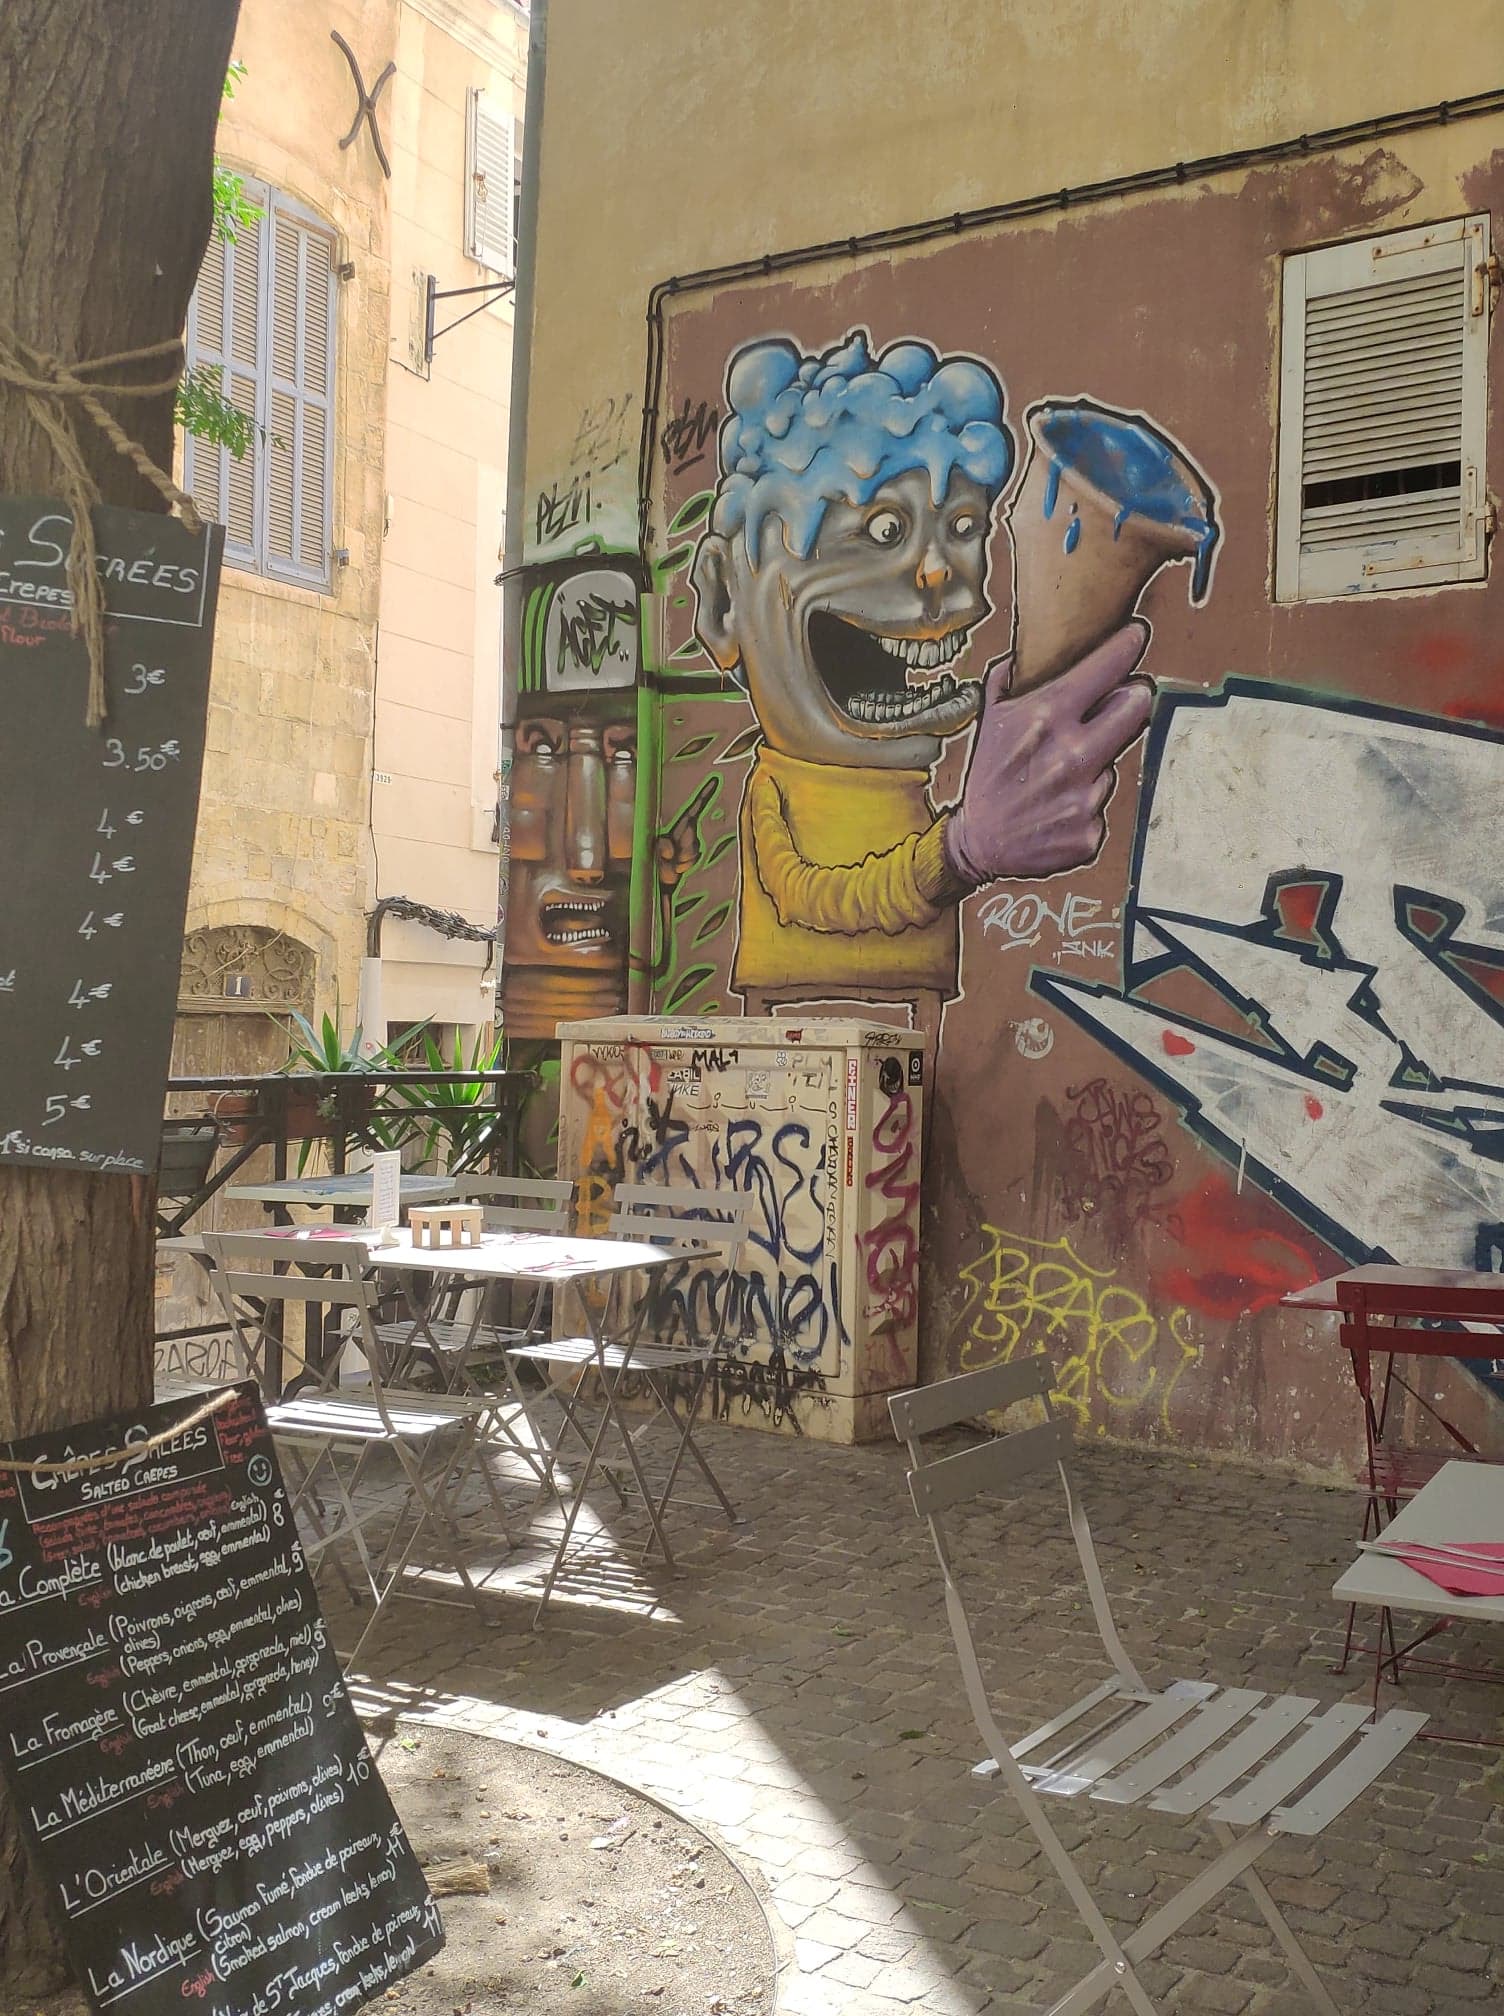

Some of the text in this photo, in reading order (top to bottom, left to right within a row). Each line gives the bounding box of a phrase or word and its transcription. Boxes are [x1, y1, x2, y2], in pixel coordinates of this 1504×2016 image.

[124, 663, 166, 694] 3€
[103, 738, 180, 772] 3.50€
[41, 1094, 91, 1127] 5€
[79, 1150, 105, 1162] sur
[100, 1149, 144, 1169] place
[81, 1465, 178, 1501] SALTED CREPES
[0, 1591, 16, 1607] a
[20, 1553, 102, 1601] Complète
[164, 1528, 198, 1563] poulet,
[221, 1499, 268, 1534] emmental)
[114, 1571, 162, 1597] (chicken
[161, 1553, 200, 1579] breast,
[221, 1524, 271, 1556] emmental)
[26, 1628, 109, 1669] Provençale
[108, 1611, 175, 1643] (Poivrons,
[174, 1594, 217, 1623] oignons,
[240, 1553, 293, 1590] emmental,
[119, 1651, 172, 1678] (Peppers,
[173, 1636, 208, 1658] onions,
[207, 1628, 231, 1649] egg,
[230, 1603, 277, 1634] emmental,
[276, 1587, 303, 1616] olives)
[124, 1629, 161, 1654] olives)
[10, 1733, 42, 1758] La
[43, 1708, 119, 1744] Fromagère
[122, 1685, 183, 1717] (Chèvre,
[182, 1656, 236, 1693] emmental,
[289, 1626, 312, 1650] miel)
[132, 1714, 166, 1740] (Goat
[168, 1707, 203, 1731] cheese,
[201, 1682, 246, 1714] emmental,
[290, 1648, 320, 1675] honey)
[31, 1806, 62, 1832] La
[176, 1737, 220, 1769] (Thon,
[249, 1692, 313, 1736] emmental)
[185, 1765, 232, 1794] (Tuna,
[230, 1756, 257, 1779] egg,
[257, 1715, 314, 1759] emmental)
[59, 1841, 169, 1910] L'Orientale
[169, 1817, 238, 1857] (Merguez,
[267, 1780, 312, 1817] poivrons,
[312, 1754, 344, 1787] olives)
[181, 1847, 239, 1880] (Merguez,
[238, 1833, 266, 1858] egg,
[265, 1808, 312, 1847] peppers,
[310, 1783, 344, 1815] olives)
[88, 1968, 125, 1996] La
[120, 1931, 197, 1980] Nordique
[196, 1900, 262, 1942] (Saumon
[256, 1872, 295, 1906] fumé,
[288, 1862, 325, 1891] fondue
[325, 1848, 338, 1869] de
[338, 1832, 382, 1872] poireaux,
[211, 1936, 268, 1982] (Smoked
[267, 1922, 310, 1951] salmon,
[309, 1902, 342, 1927] cream
[368, 1859, 396, 1890] lemon)
[215, 1922, 252, 1955] citron)
[283, 1957, 340, 2001] Jacques,
[333, 1941, 371, 1966] fondue
[371, 1922, 385, 1945] de
